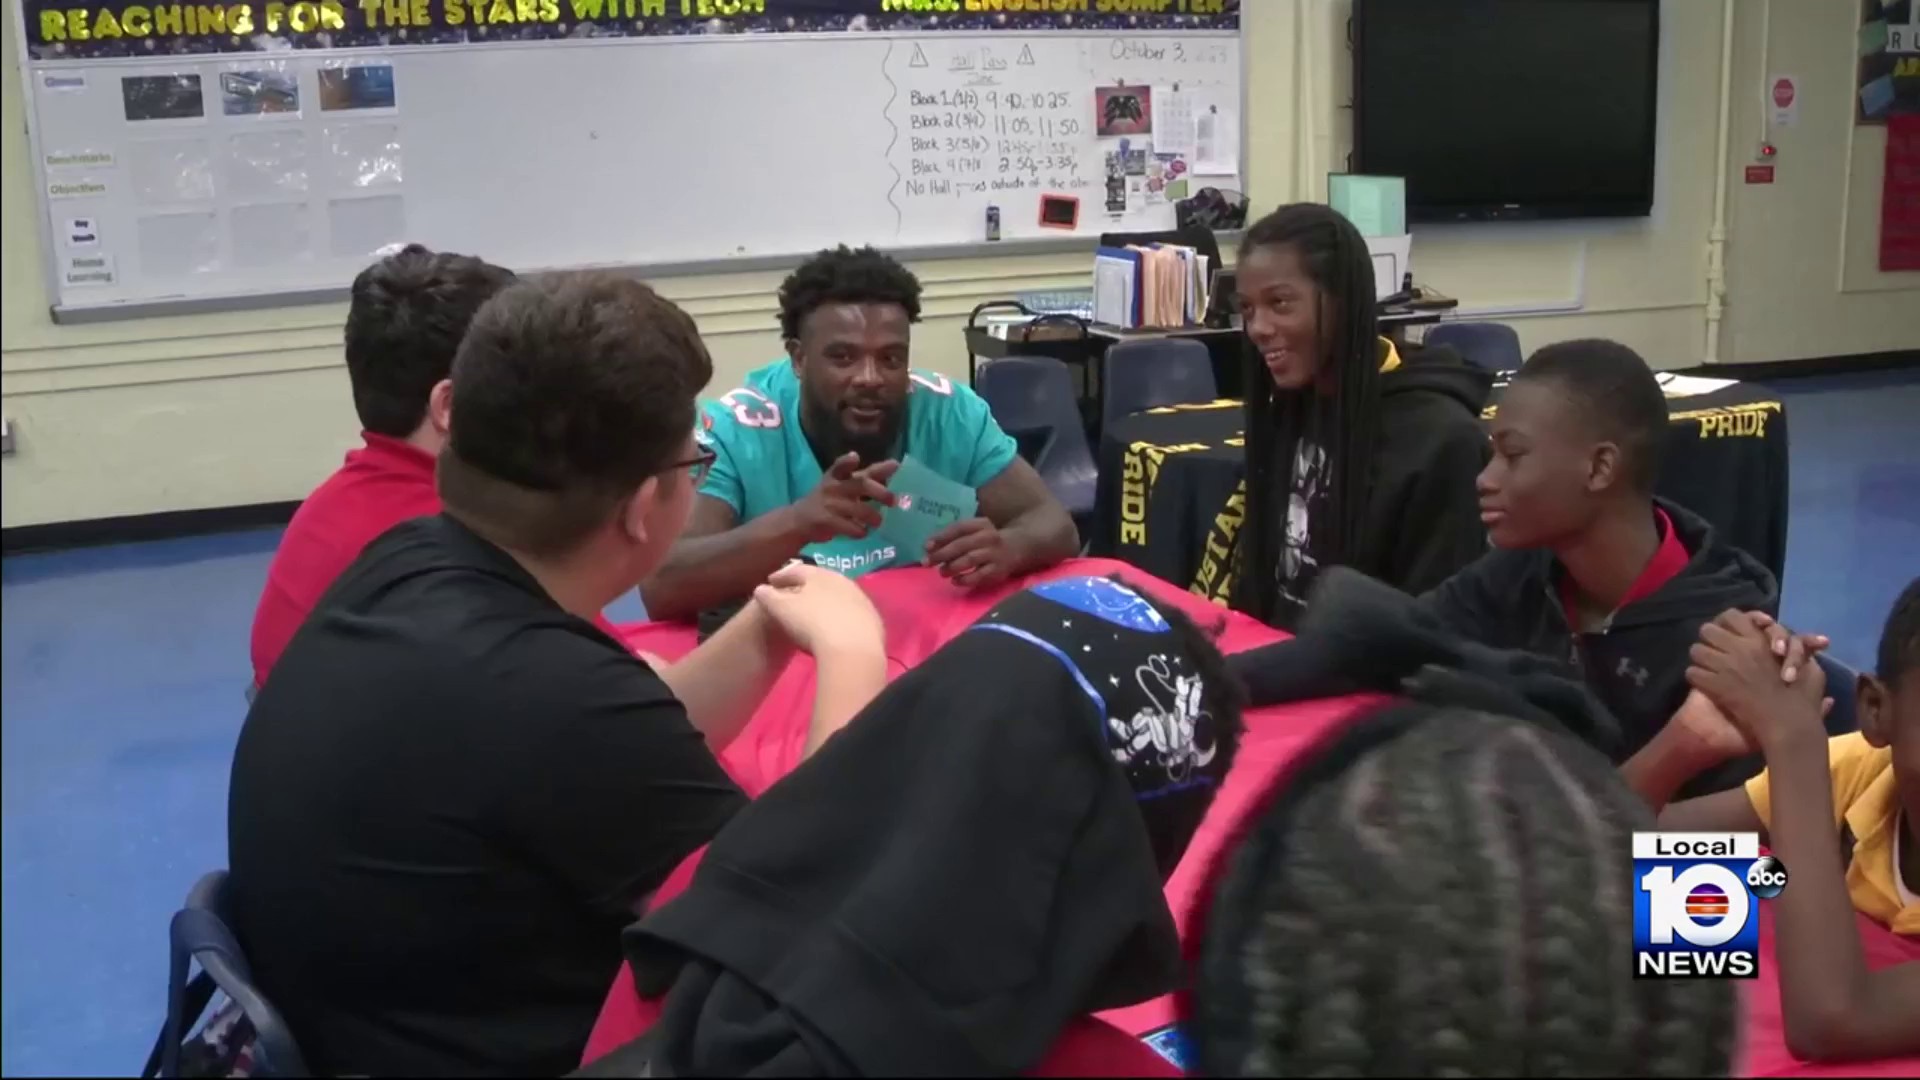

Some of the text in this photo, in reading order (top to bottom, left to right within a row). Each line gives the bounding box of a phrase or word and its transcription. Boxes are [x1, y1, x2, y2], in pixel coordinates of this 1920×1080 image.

[39, 3, 254, 41] REACHING
[264, 1, 345, 33] FOR
[359, 0, 430, 27] THE
[446, 0, 560, 25] STARS
[569, 0, 666, 19] WITH
[911, 135, 941, 152] Block
[912, 158, 941, 175] Block
[906, 179, 924, 198] No
